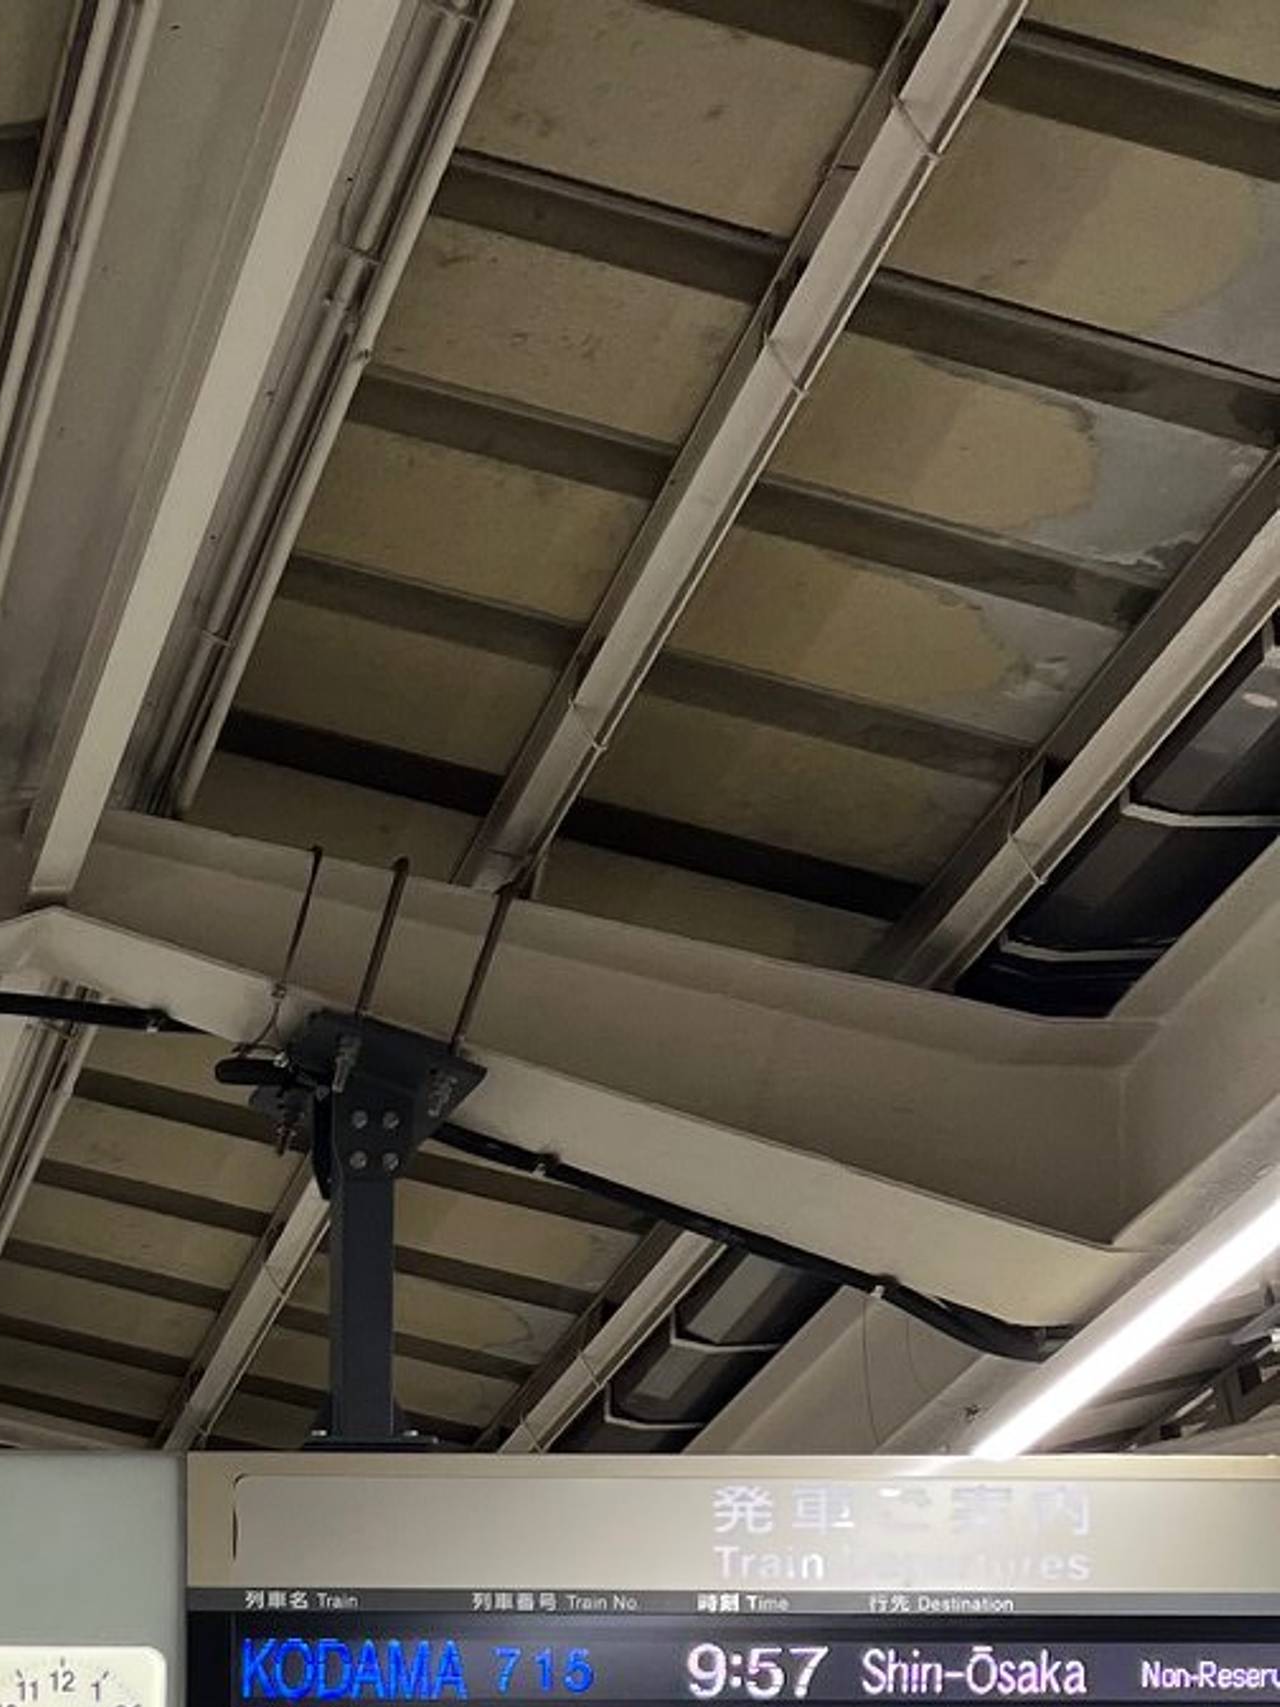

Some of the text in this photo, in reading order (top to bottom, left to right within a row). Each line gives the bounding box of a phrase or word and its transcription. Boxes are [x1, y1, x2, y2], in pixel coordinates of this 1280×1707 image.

[713, 1546, 824, 1579] Train
[244, 1591, 359, 1609] 列車名 Train
[471, 1592, 557, 1612] 列車番号
[567, 1594, 607, 1610] Train
[697, 1593, 790, 1613] 時刻 Time
[869, 1595, 1014, 1614] 行先 Destination
[243, 1638, 467, 1700] KODAMA
[492, 1644, 596, 1694] 715
[687, 1643, 828, 1699] 9:57
[862, 1646, 1086, 1695] Shin-Ōsaka
[18, 1681, 38, 1701] 11
[50, 1671, 75, 1692] 12
[91, 1681, 101, 1702] 1
